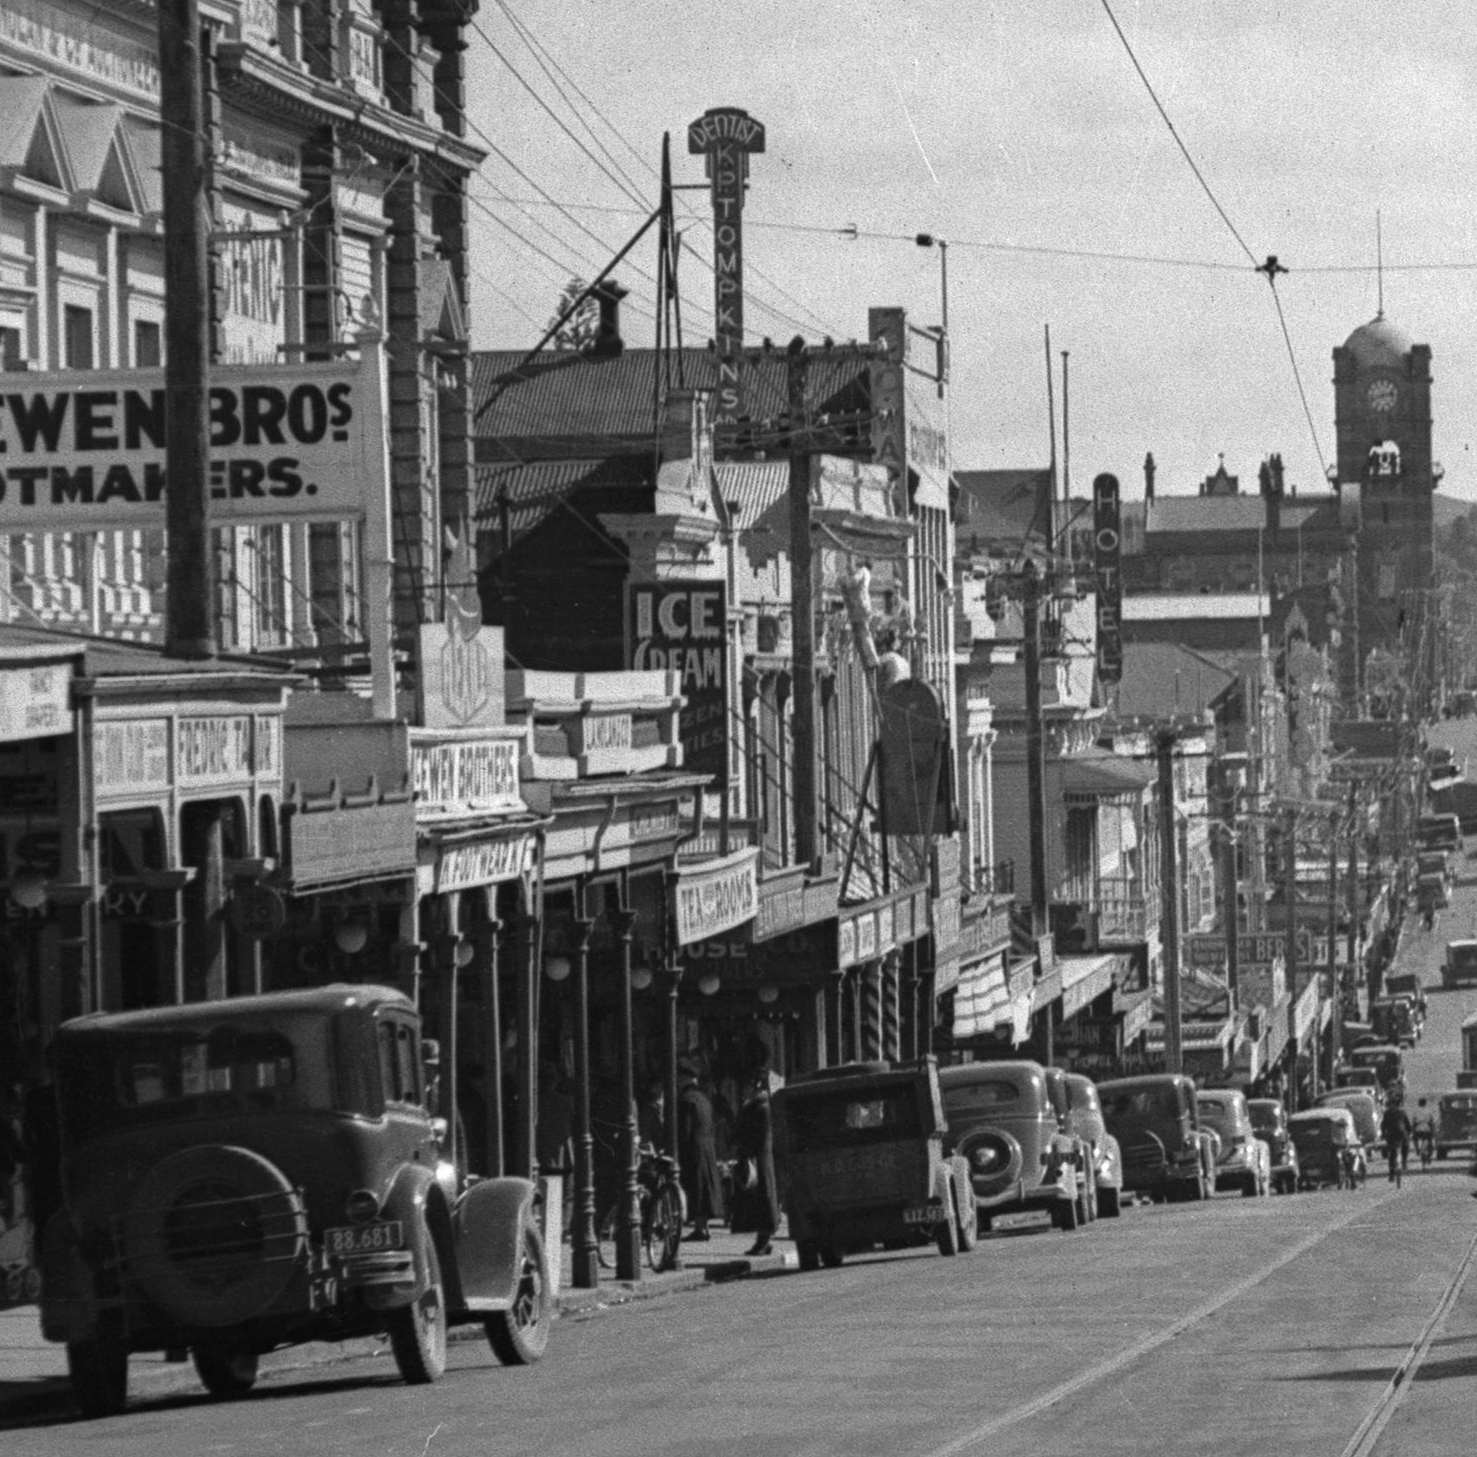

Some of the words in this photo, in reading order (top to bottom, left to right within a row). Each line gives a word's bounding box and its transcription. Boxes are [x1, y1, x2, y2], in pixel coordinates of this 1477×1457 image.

[690, 113, 763, 149] DENTIST
[1095, 487, 1119, 671] HOTEL
[637, 591, 722, 639] ICE
[332, 1225, 391, 1251] 88.681
